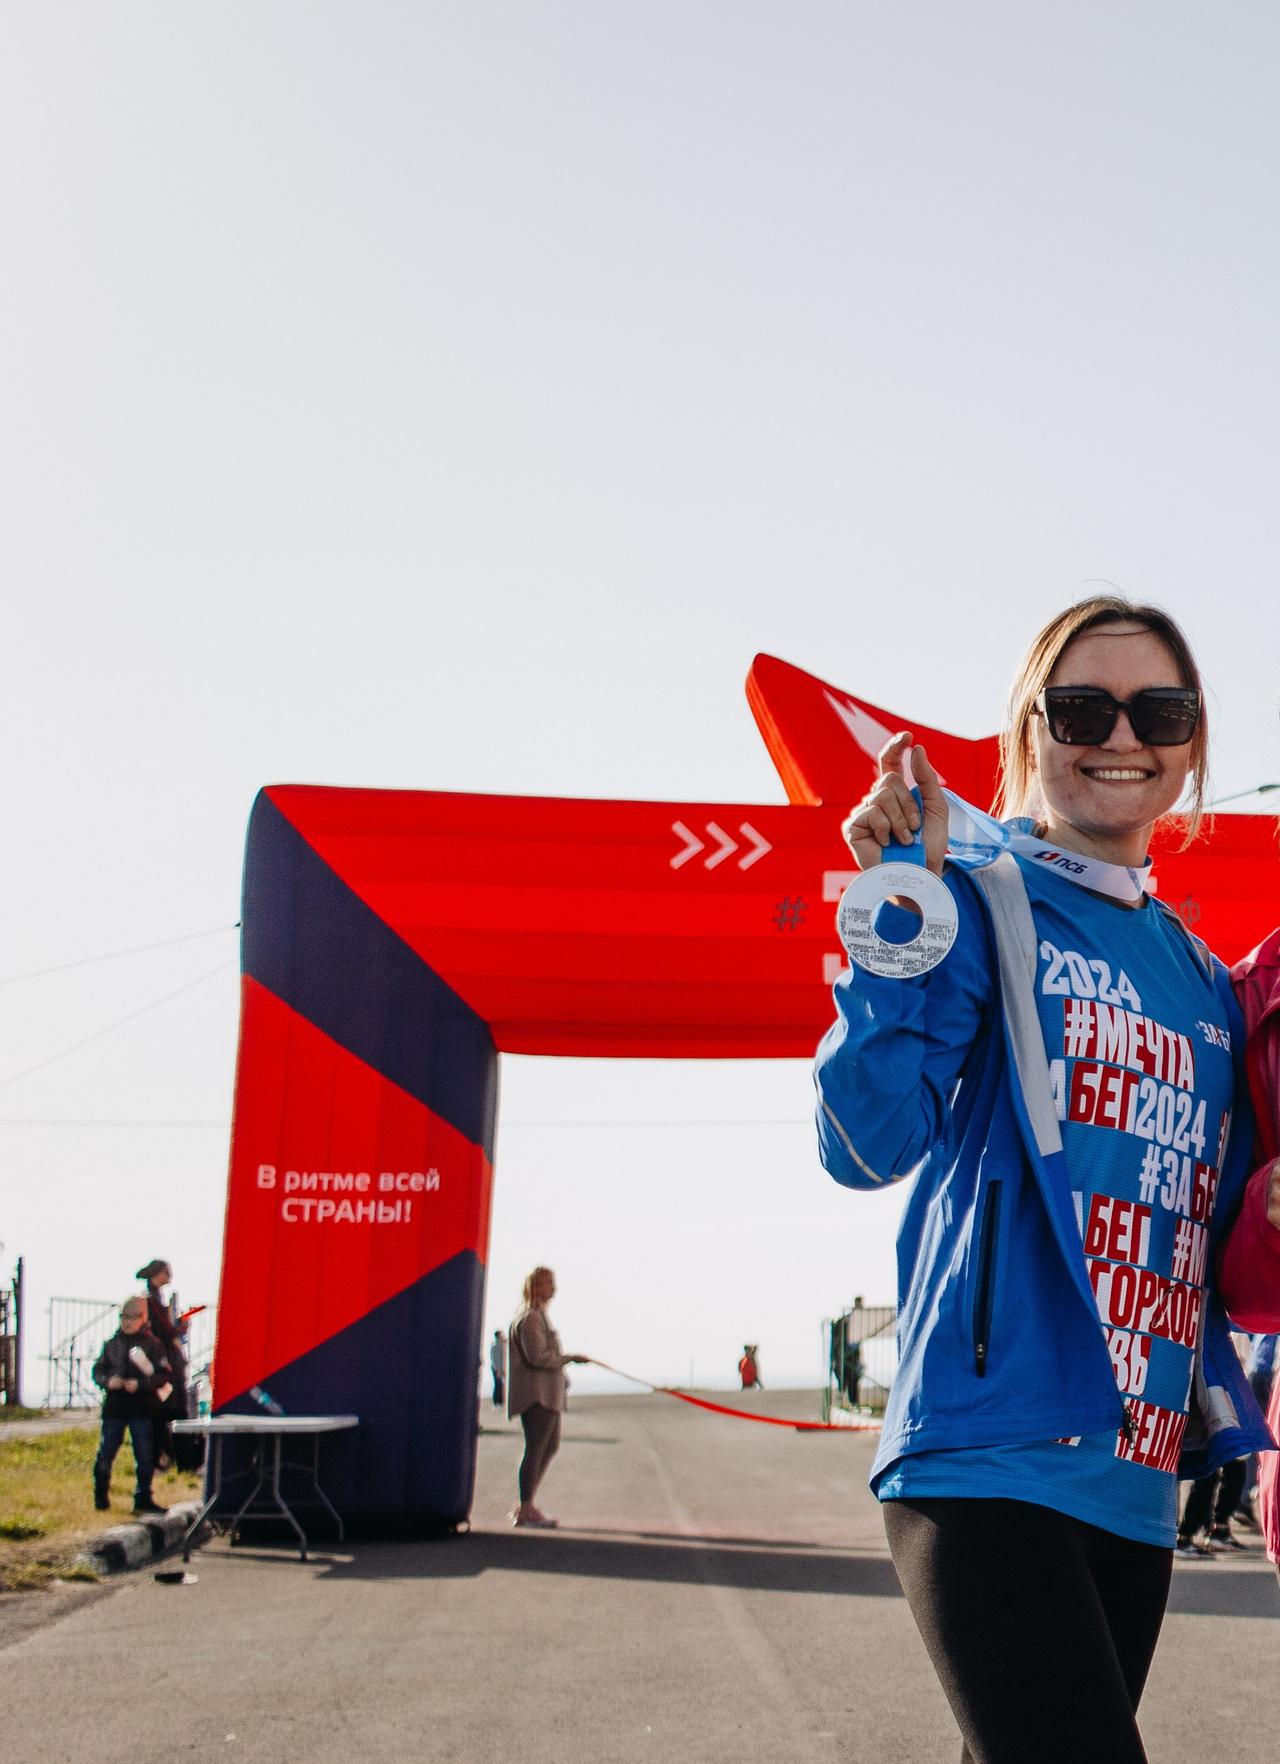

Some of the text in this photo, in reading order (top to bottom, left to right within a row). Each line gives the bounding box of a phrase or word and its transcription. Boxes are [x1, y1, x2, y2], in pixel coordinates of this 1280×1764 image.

[1055, 857, 1090, 875] ПСБ
[1040, 940, 1142, 1012] 2024
[1065, 999, 1194, 1093] #МЕЧТА
[1050, 1059, 1207, 1156] АБЕГ2024
[257, 1164, 441, 1193] В ритме всей
[282, 1197, 412, 1223] СТРАНЫ!
[1139, 1141, 1217, 1223] #ЗАБЕ
[1074, 1192, 1152, 1268] БЕГ
